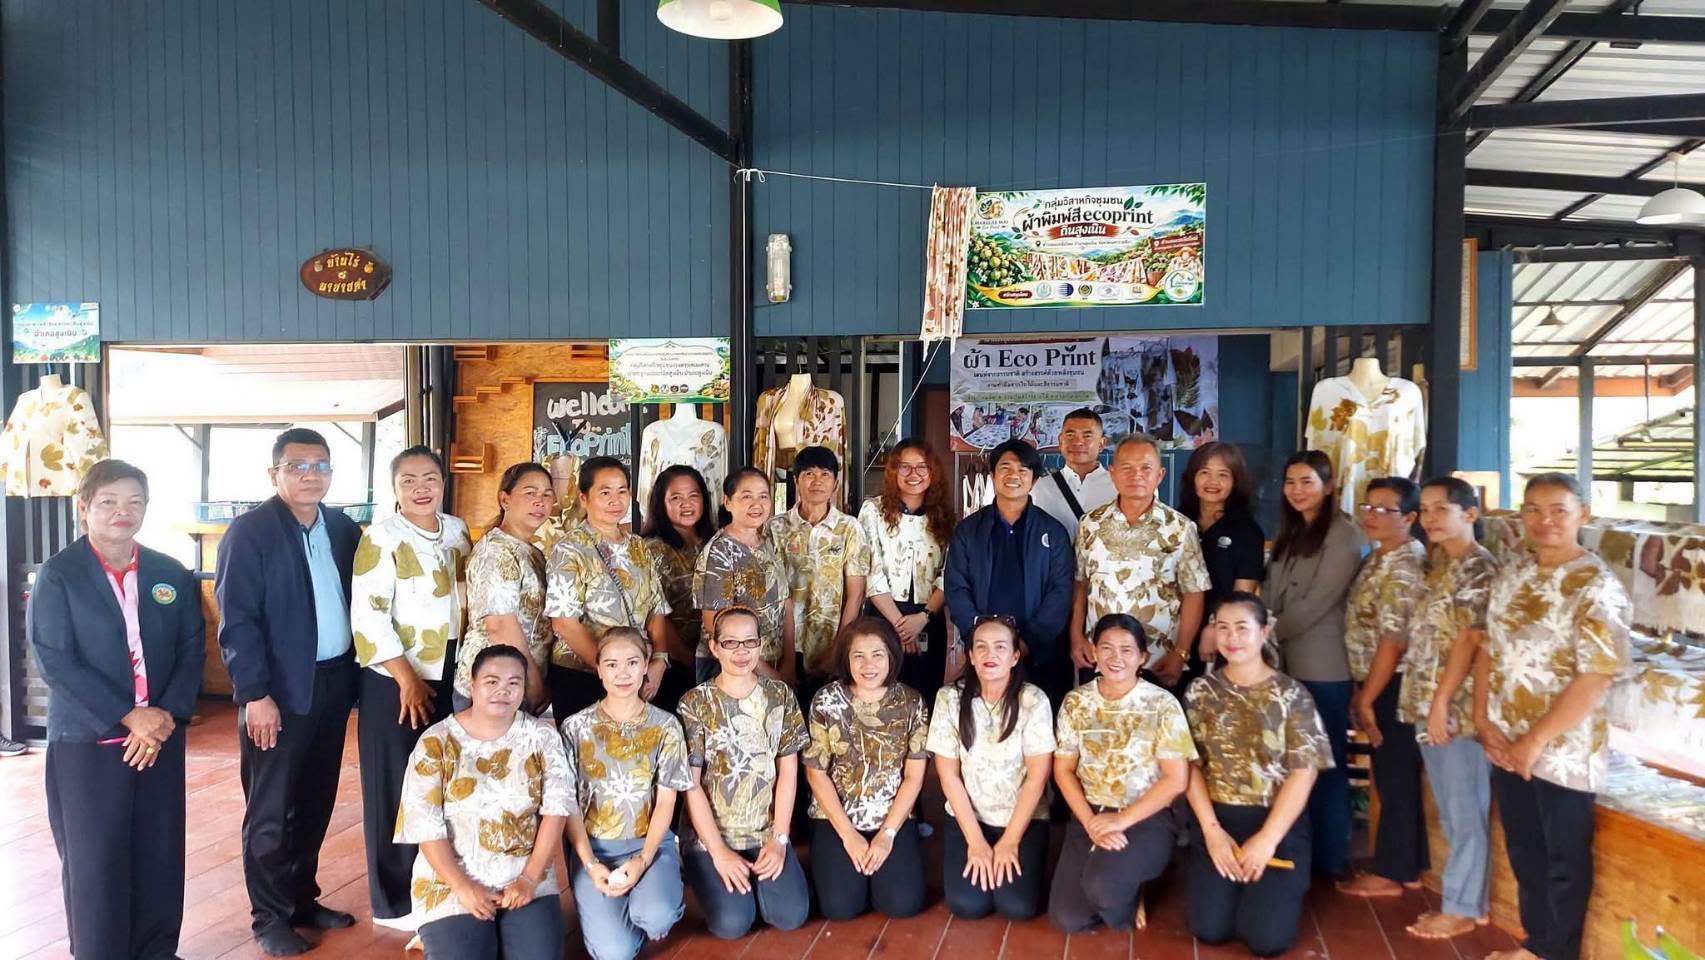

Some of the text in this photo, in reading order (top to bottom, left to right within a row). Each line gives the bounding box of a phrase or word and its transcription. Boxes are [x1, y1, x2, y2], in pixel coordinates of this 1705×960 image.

[1083, 208, 1154, 224] ecoprint
[963, 348, 1096, 369] ผ้า Eco Print
